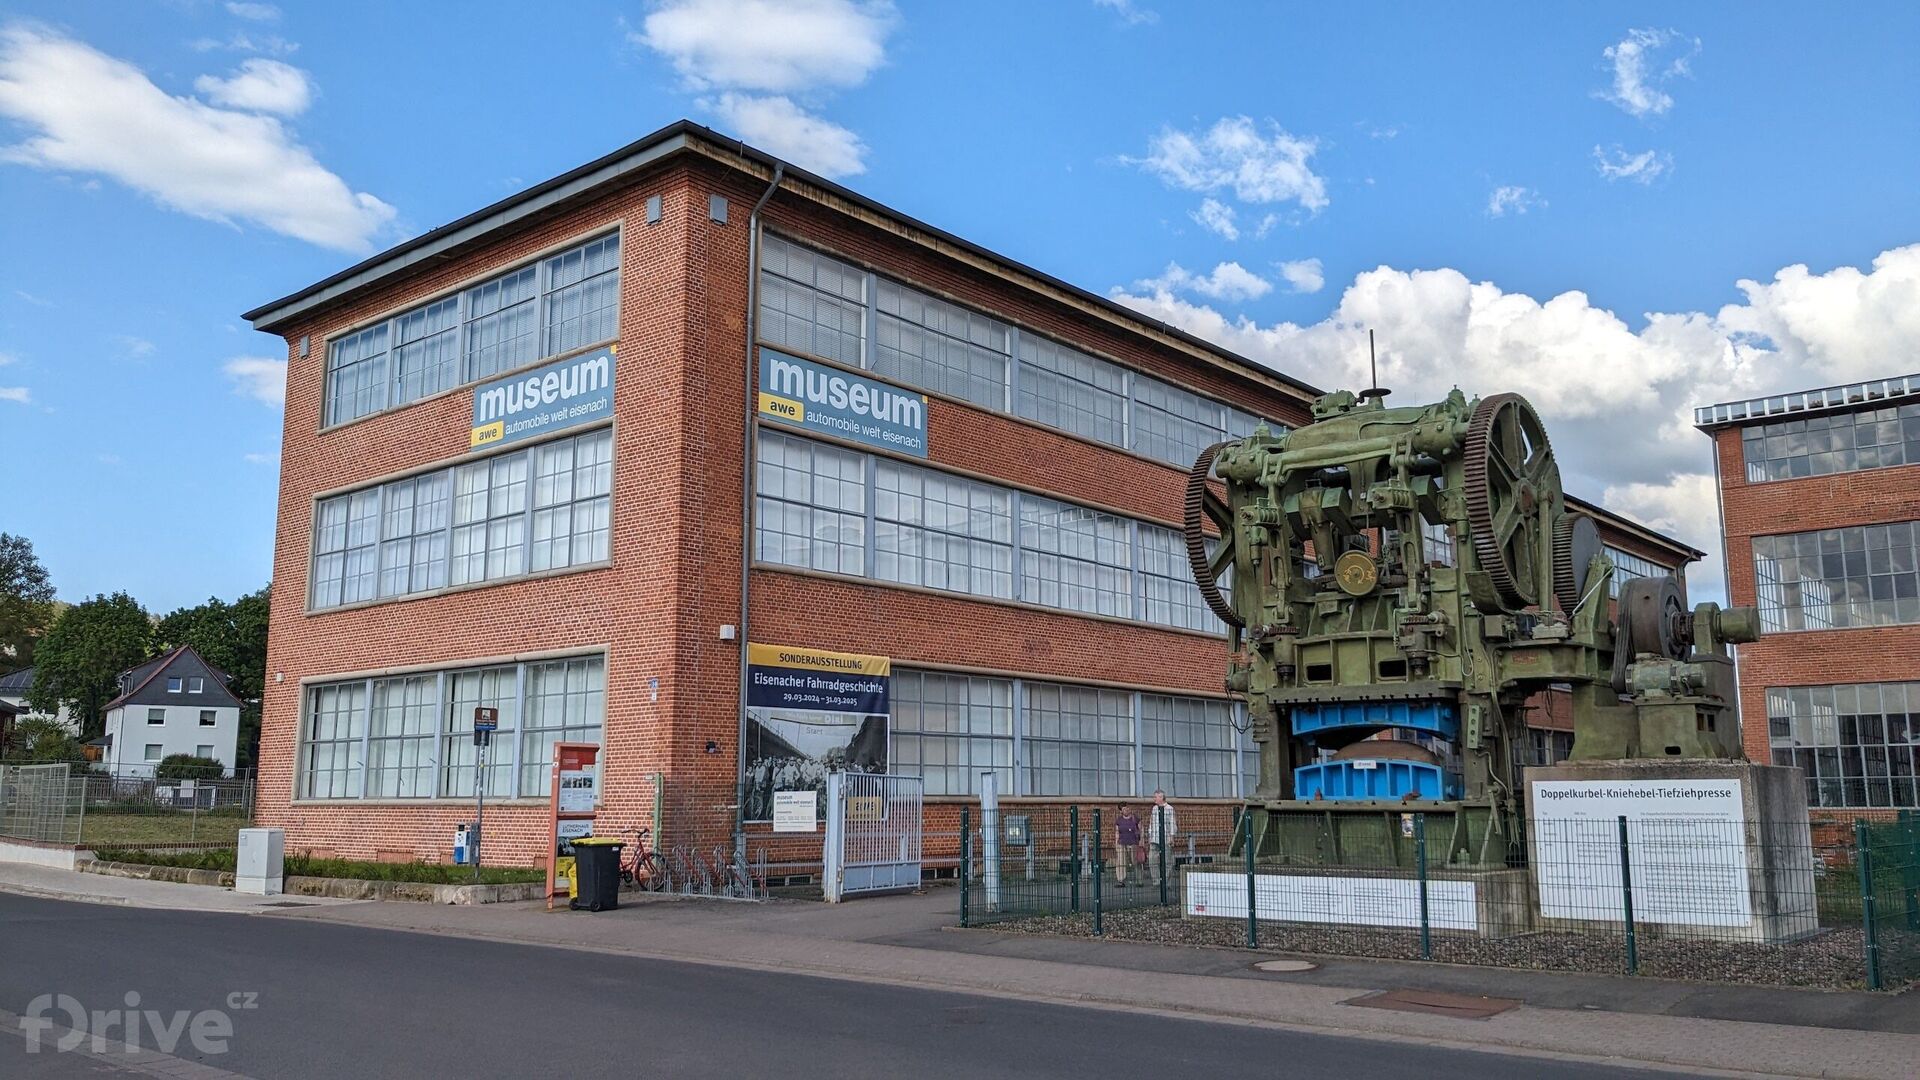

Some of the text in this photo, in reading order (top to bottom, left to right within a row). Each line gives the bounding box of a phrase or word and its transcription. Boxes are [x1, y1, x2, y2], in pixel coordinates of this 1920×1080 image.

[479, 355, 609, 422] museum
[769, 358, 922, 430] museum
[505, 396, 608, 435] automobile welt eisenach
[770, 400, 796, 416] awe
[478, 427, 498, 441] awe
[806, 410, 921, 449] automobile welt eisenach
[779, 652, 862, 669] SONDERAUSSTELLUNG
[754, 672, 884, 693] Eisenacher Fahrradgeschichte
[783, 693, 820, 704] 29.03.2024
[825, 696, 858, 706] 31.03.2025
[806, 727, 823, 735] Start
[1540, 788, 1732, 800] Doppelkurbel-Kniehebel-Tiefziehpresse
